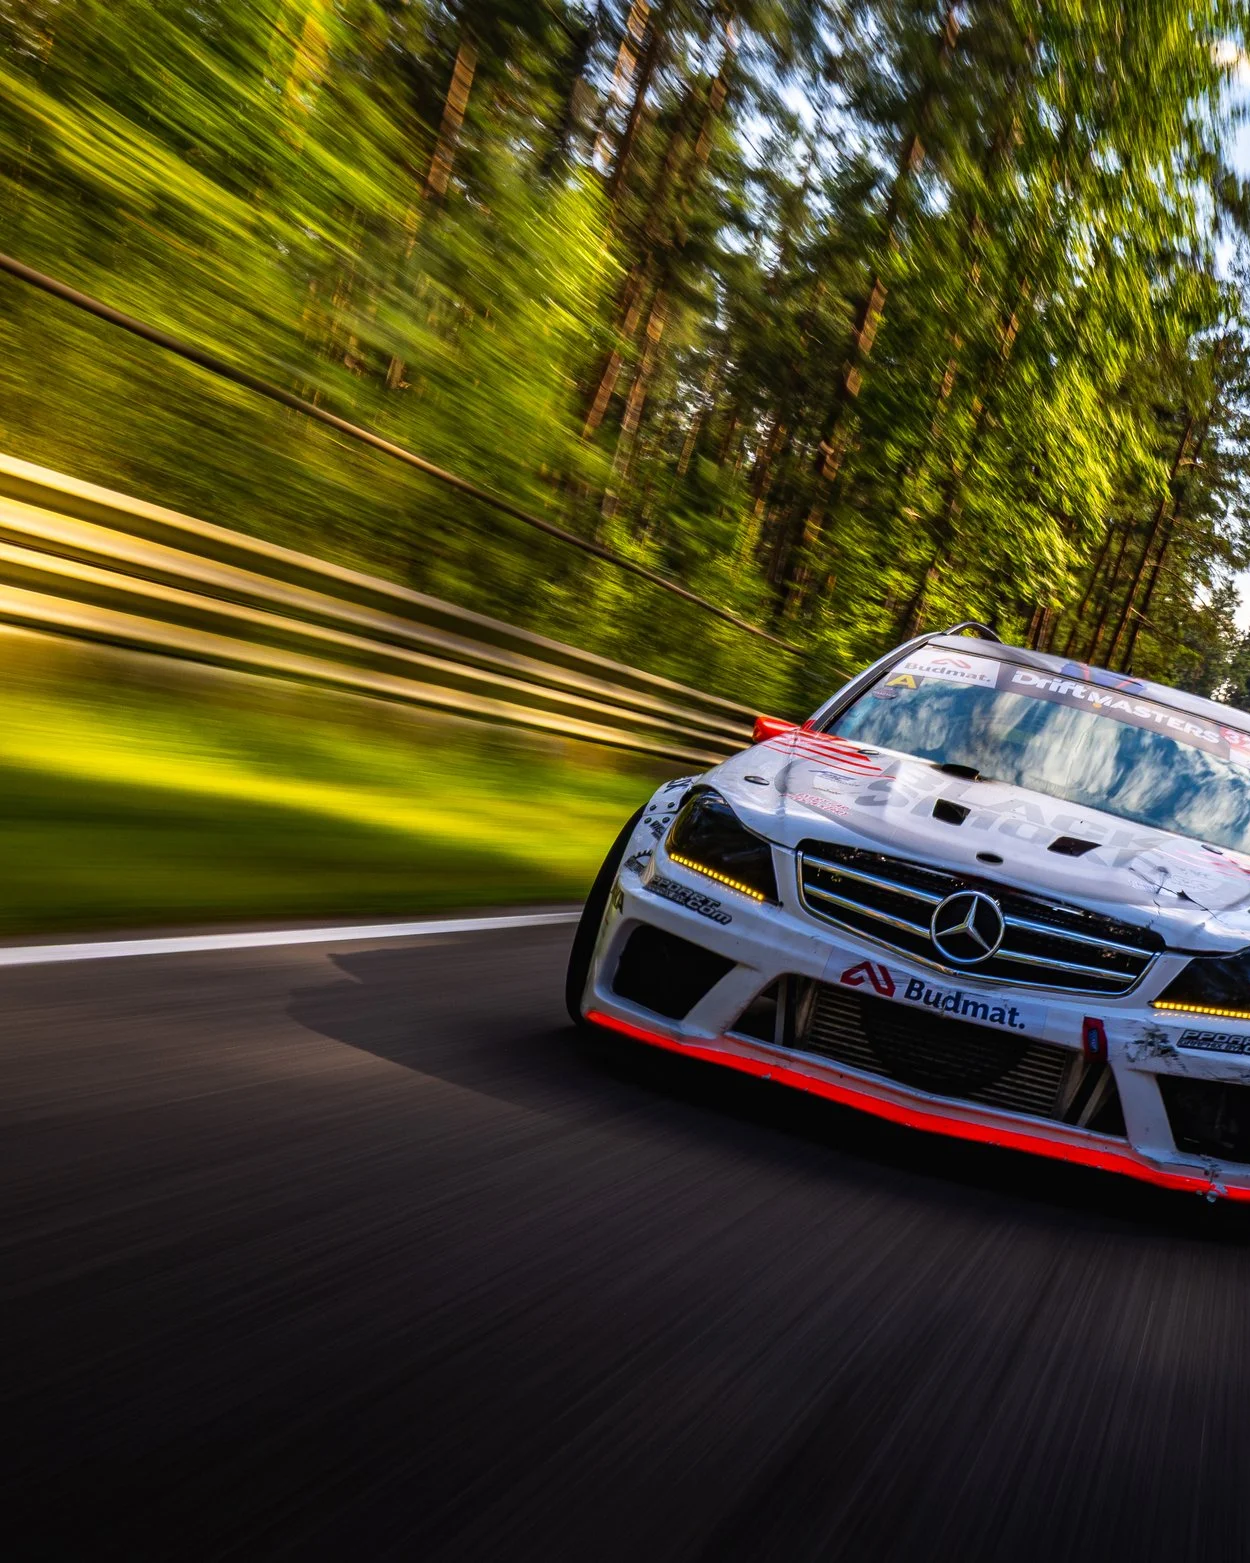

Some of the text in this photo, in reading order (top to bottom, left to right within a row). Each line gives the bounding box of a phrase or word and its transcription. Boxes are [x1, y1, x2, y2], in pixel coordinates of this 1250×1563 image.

[885, 674, 917, 690] A
[904, 661, 991, 683] Budmat.
[904, 978, 1026, 1030] Budmat.
